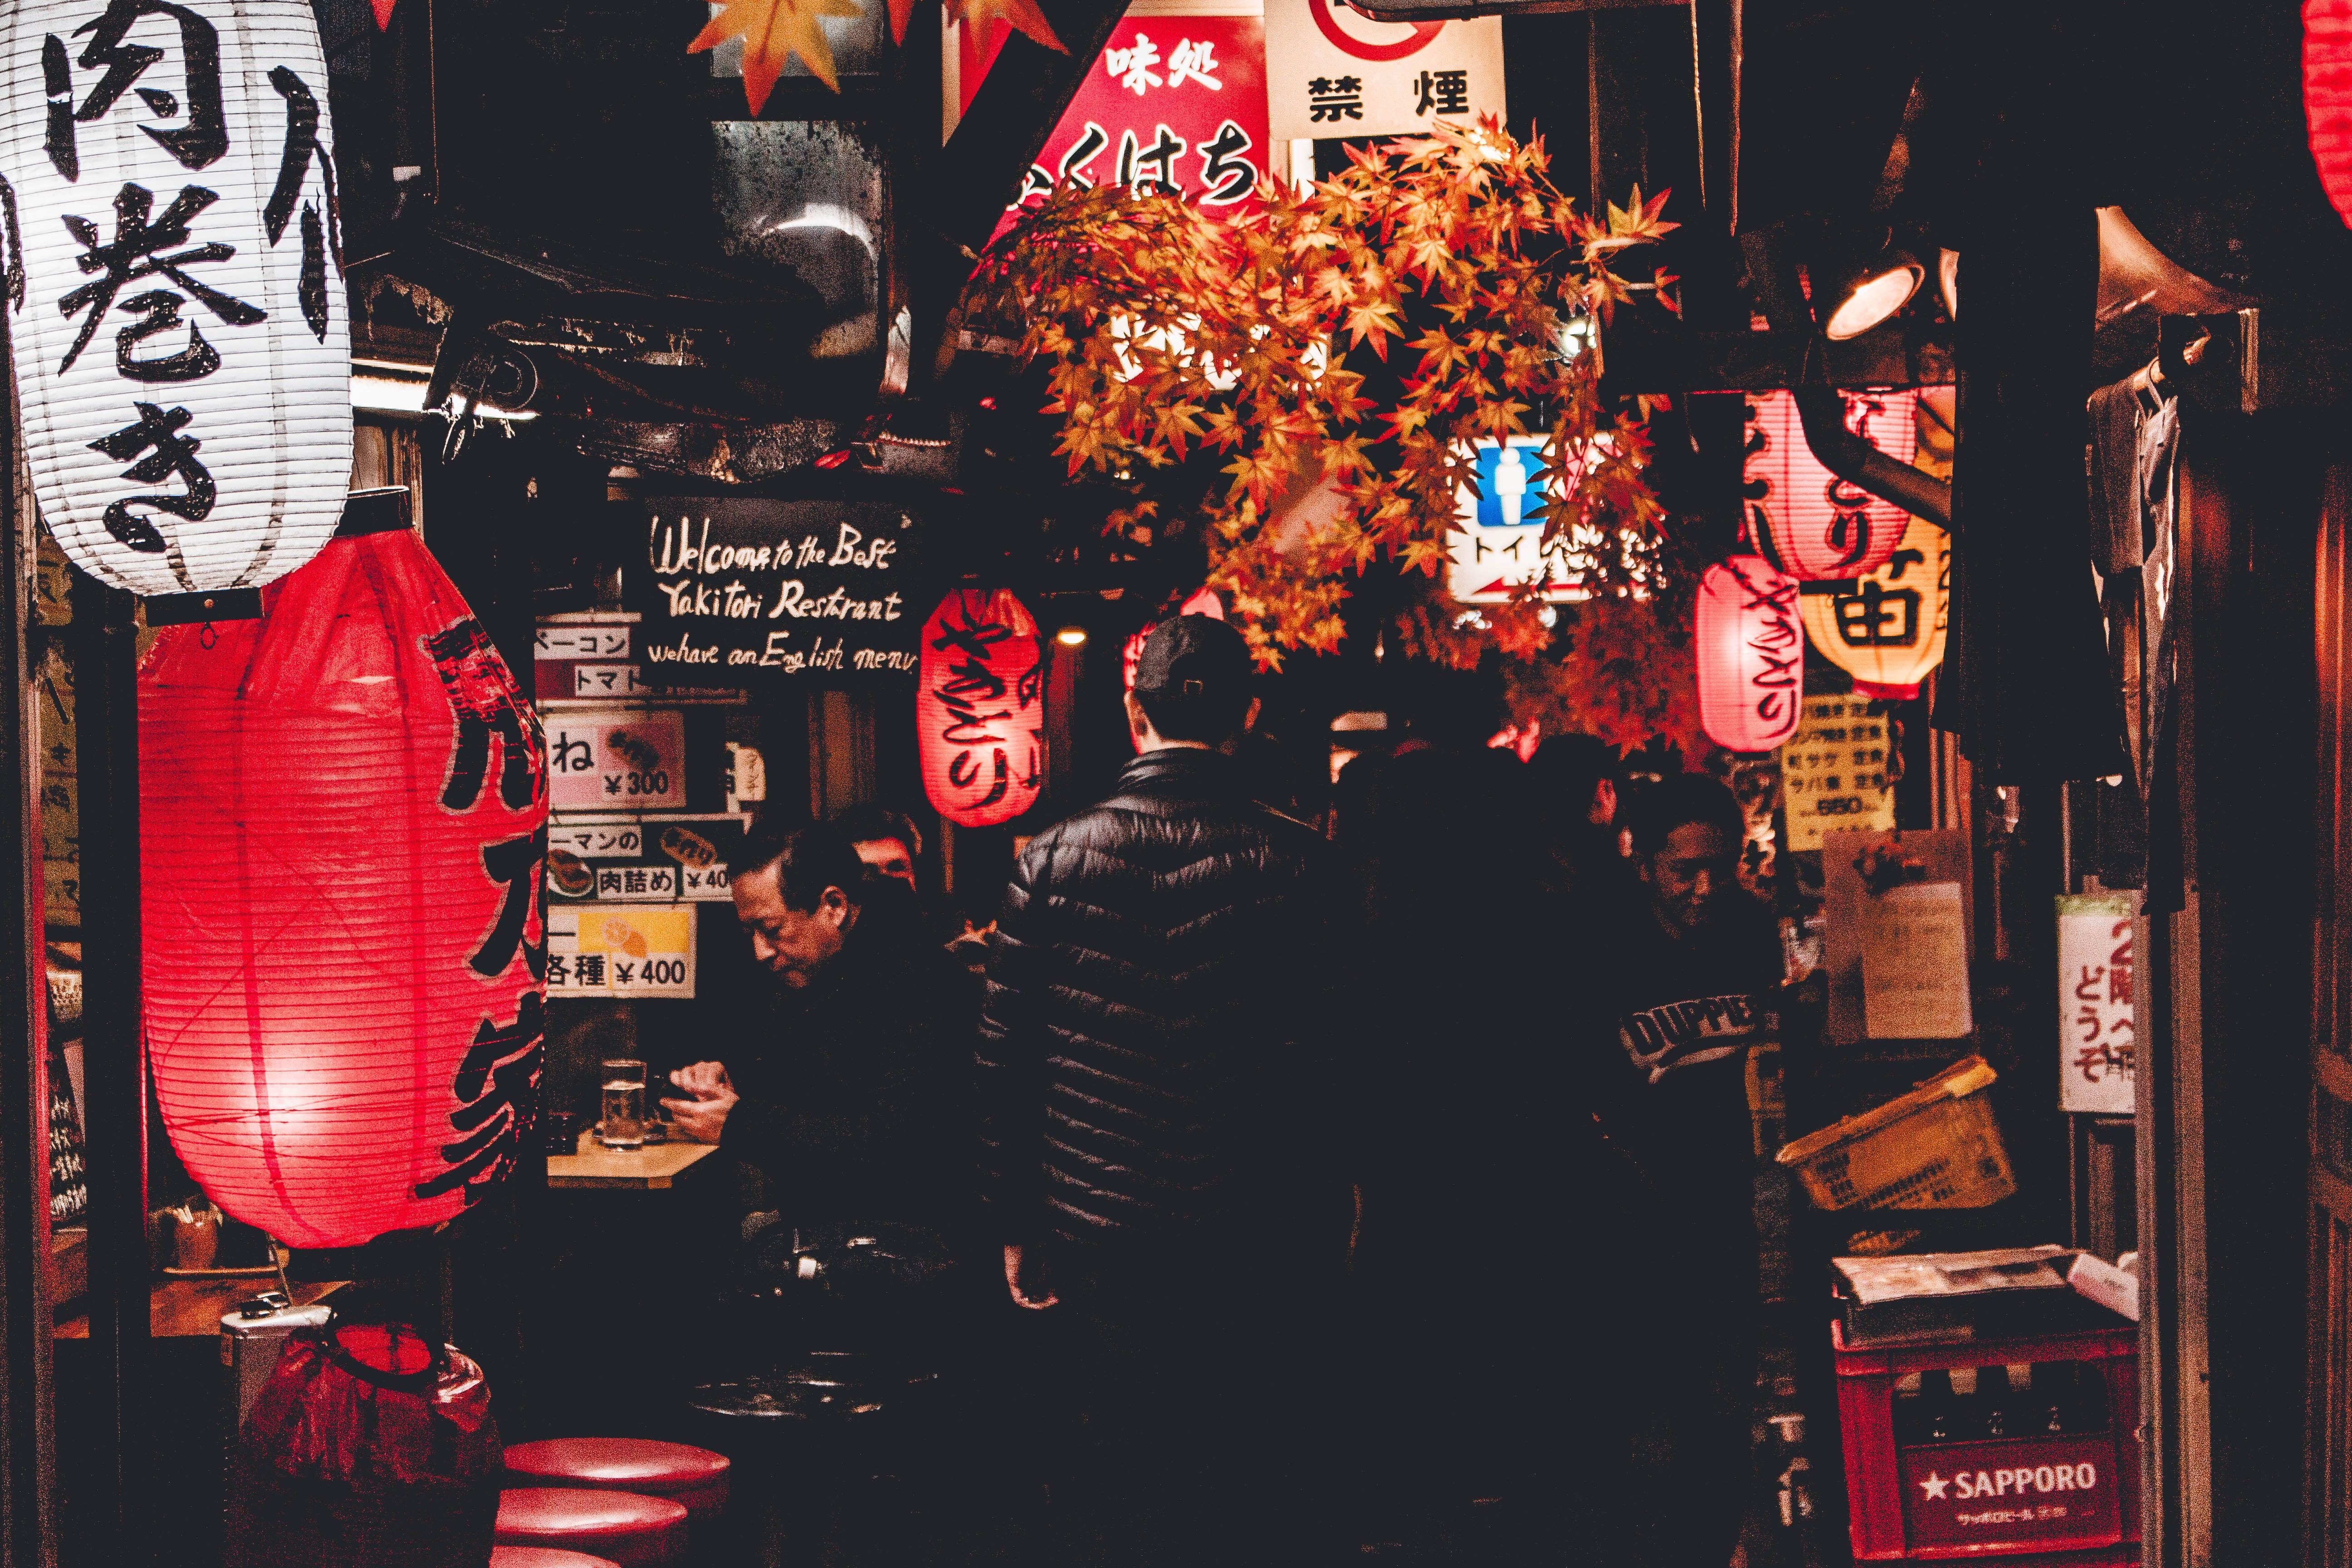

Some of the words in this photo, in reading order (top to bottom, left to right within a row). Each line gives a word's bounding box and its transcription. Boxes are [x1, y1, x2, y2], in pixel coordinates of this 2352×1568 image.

[1104, 32, 1223, 97] 味処
[1308, 70, 1469, 122] 禁煙
[42, 0, 269, 554] 肉巻き
[772, 539, 793, 570] to
[794, 535, 826, 569] the
[1475, 534, 1548, 564] トイ
[552, 731, 594, 773] ね
[604, 771, 668, 795] ¥300
[600, 870, 672, 894] 肉詰め
[687, 869, 730, 889] ¥40
[548, 954, 606, 986] 各種
[615, 959, 686, 984] ¥400
[1955, 1462, 2096, 1499] SAPPORO
